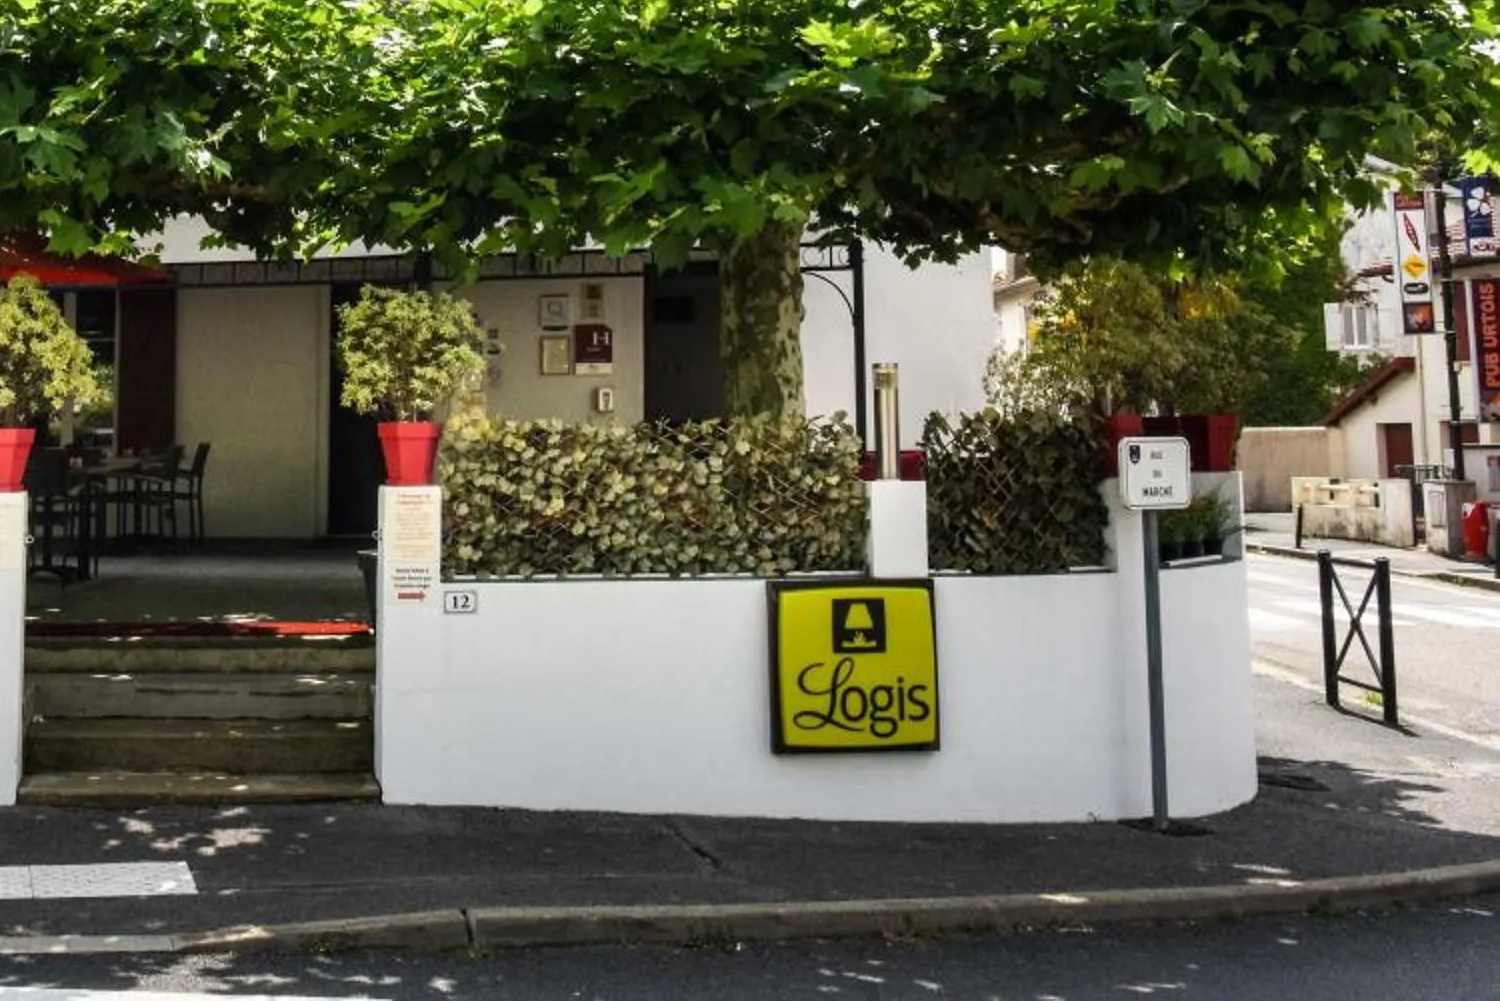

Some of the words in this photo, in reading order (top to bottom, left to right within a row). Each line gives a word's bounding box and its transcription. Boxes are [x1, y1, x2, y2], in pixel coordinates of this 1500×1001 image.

[1479, 283, 1498, 348] URTOIS
[593, 332, 609, 345] H
[1483, 353, 1500, 387] PUB
[452, 595, 470, 609] 12
[793, 657, 930, 738] Logis
